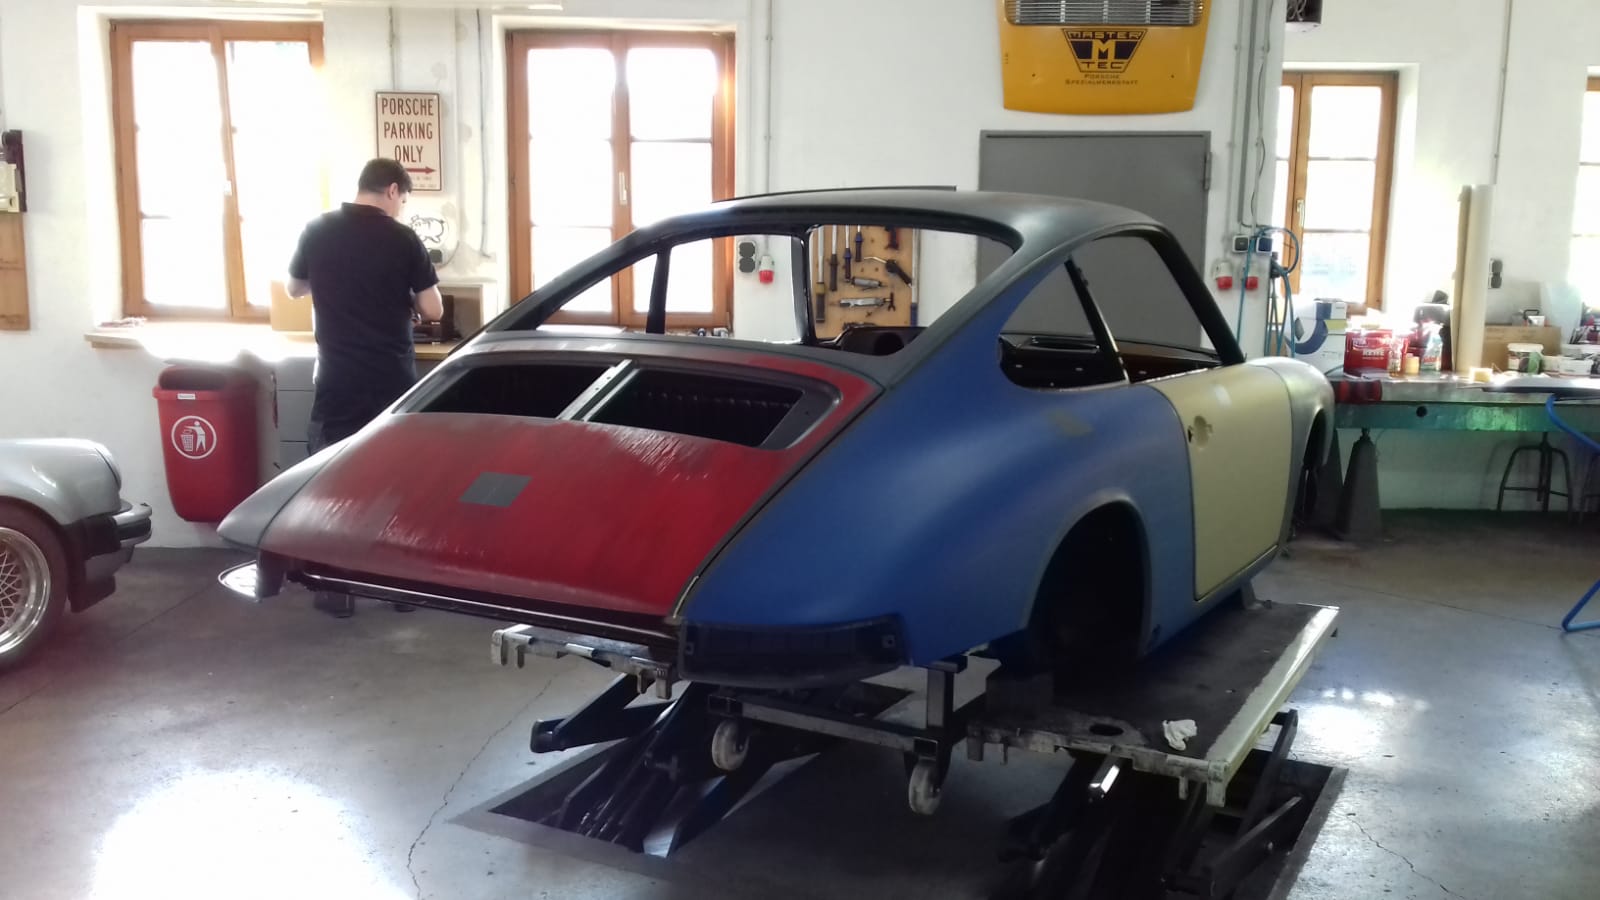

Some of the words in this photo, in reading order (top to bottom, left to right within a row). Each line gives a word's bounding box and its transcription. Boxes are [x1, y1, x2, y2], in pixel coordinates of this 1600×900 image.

[1068, 31, 1142, 39] MASTER
[1091, 40, 1116, 61] M
[1081, 61, 1124, 69] TEC
[381, 98, 434, 116] PORSCHE
[384, 121, 433, 139] PARKING
[394, 145, 423, 163] ONLY
